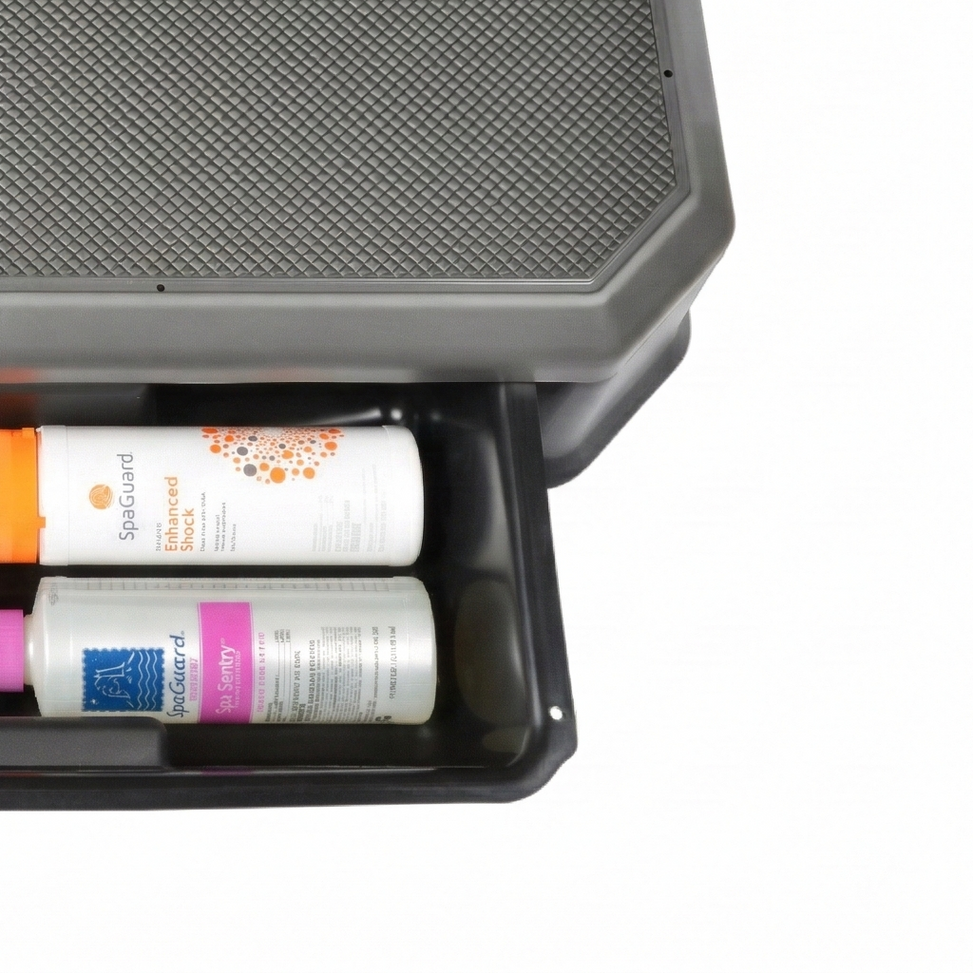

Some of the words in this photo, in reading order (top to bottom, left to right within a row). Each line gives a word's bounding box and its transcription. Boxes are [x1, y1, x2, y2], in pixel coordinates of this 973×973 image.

[117, 453, 139, 541] SpaGuard
[164, 477, 179, 552] Enhanced
[180, 508, 195, 552] Shock
[166, 634, 189, 718] SpaGuard
[217, 644, 236, 692] Sentry
